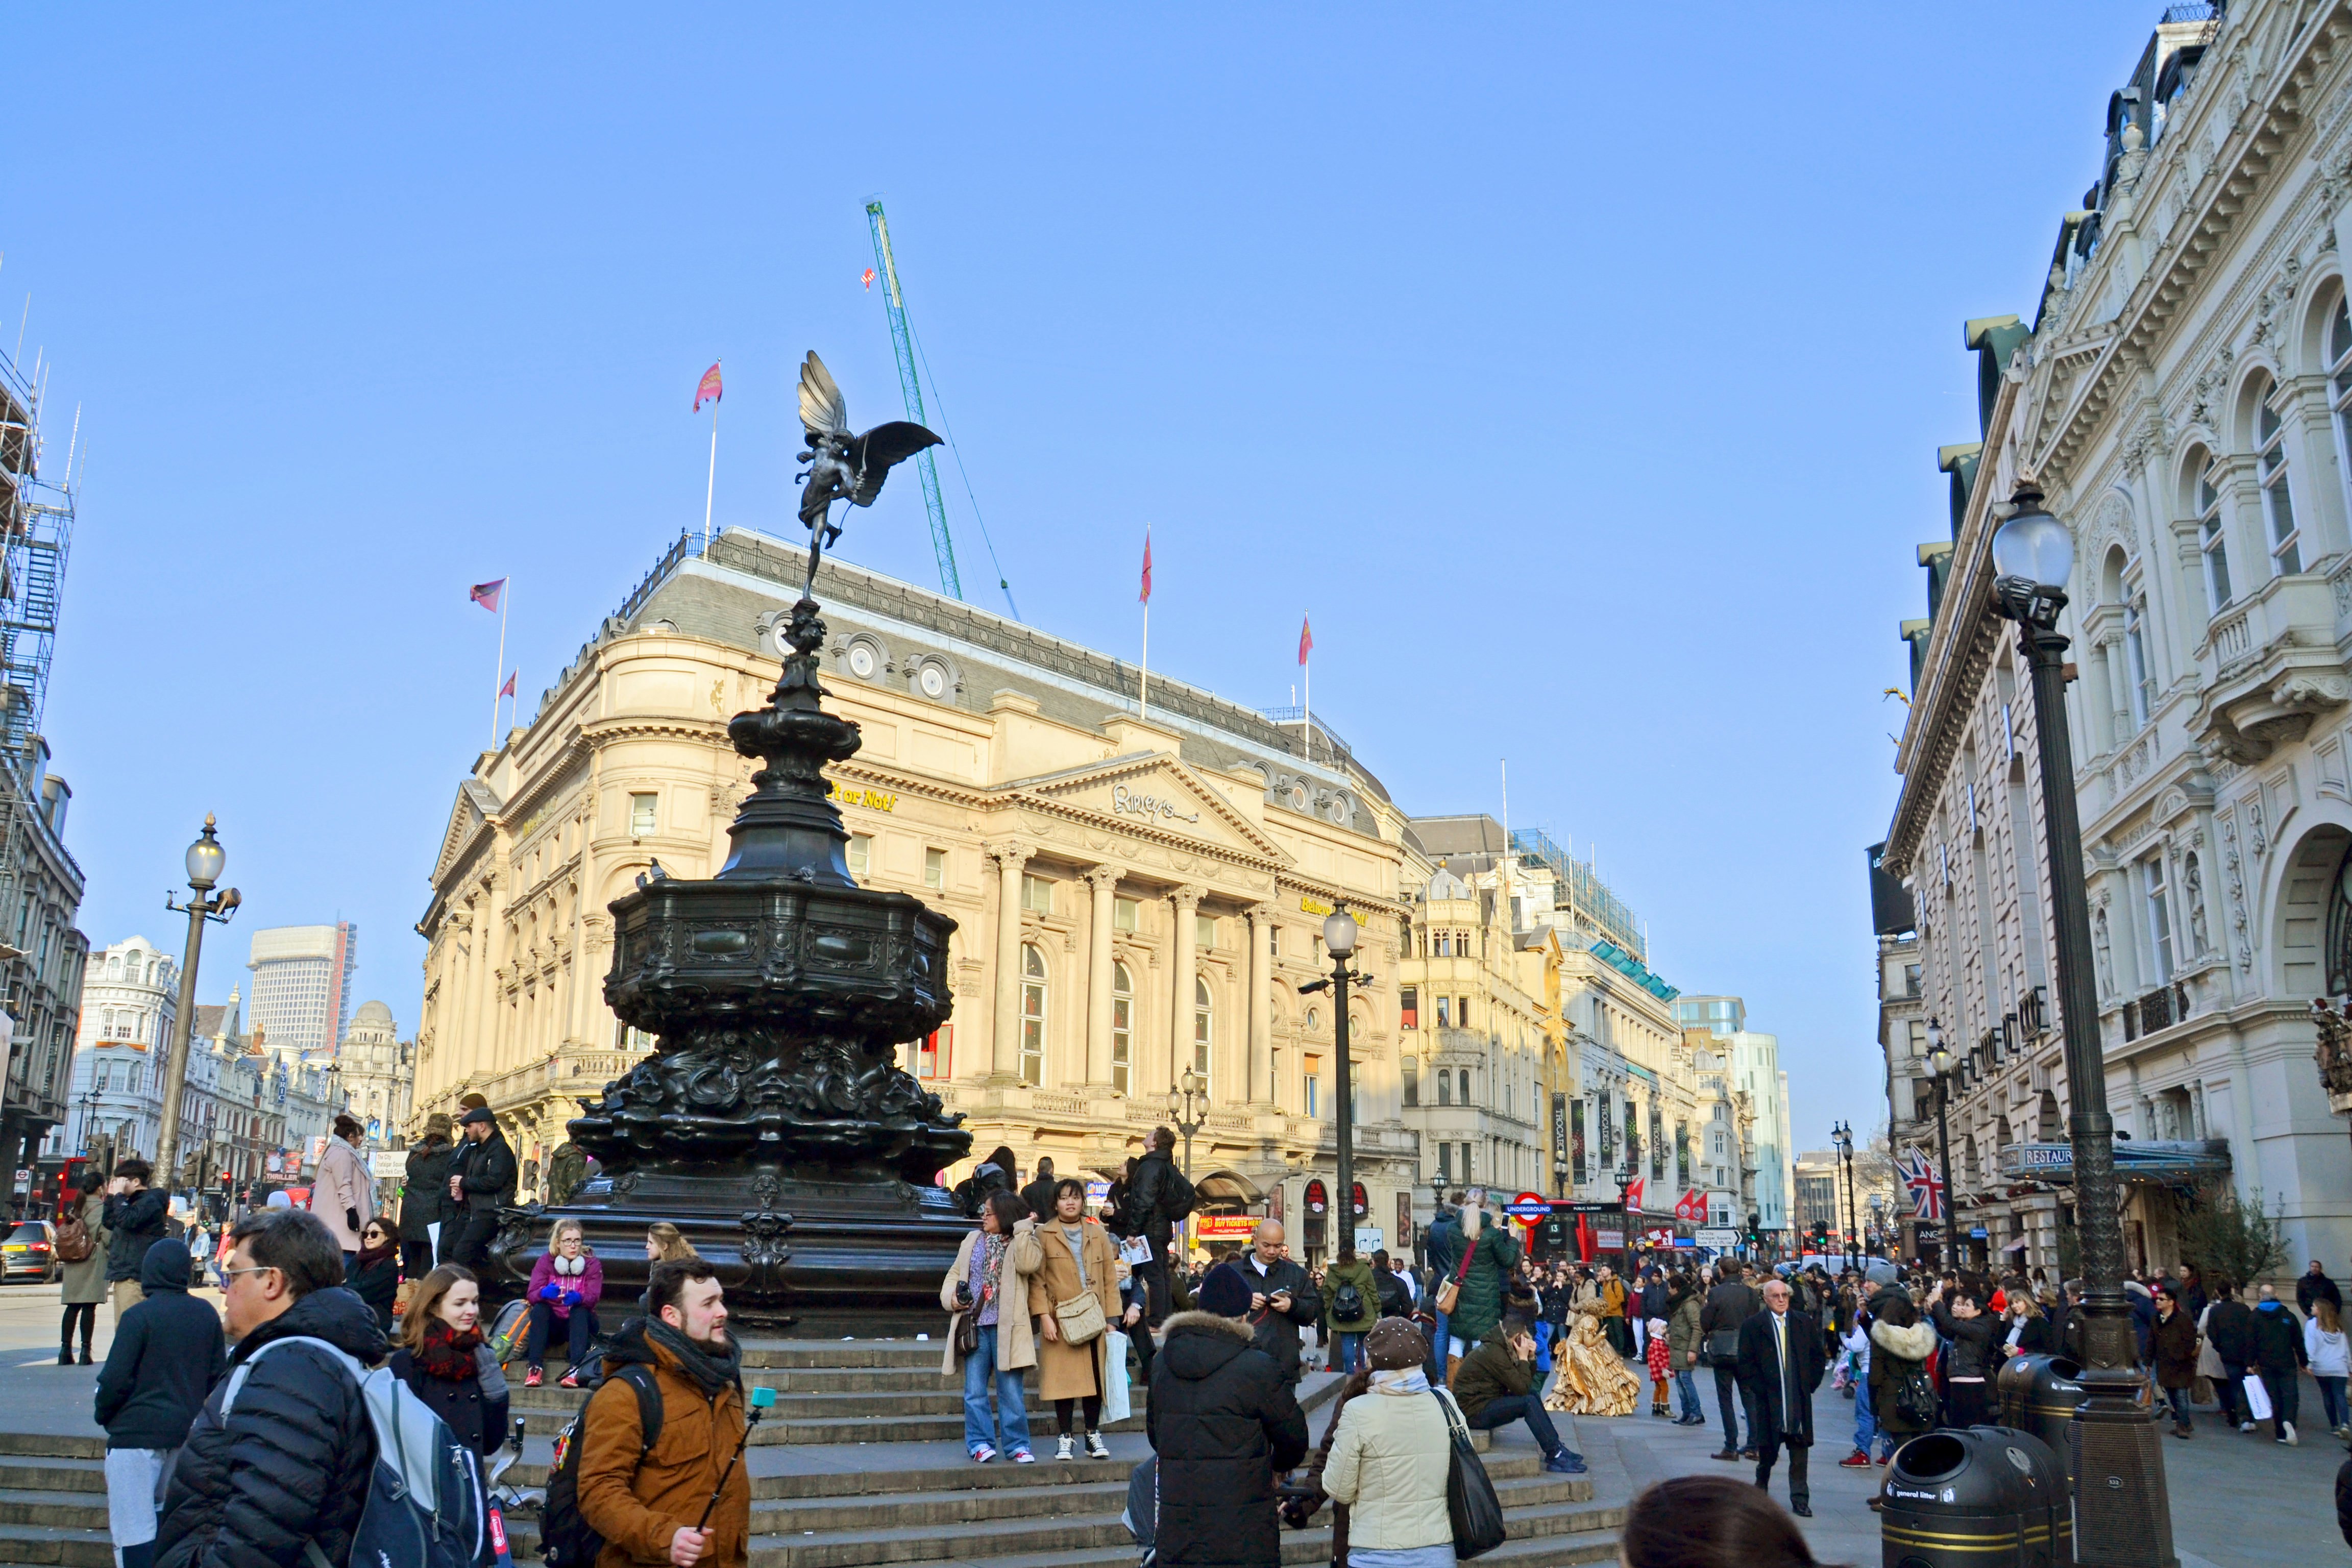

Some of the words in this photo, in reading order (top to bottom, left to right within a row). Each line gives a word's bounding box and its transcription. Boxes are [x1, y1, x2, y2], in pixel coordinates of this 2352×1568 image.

[844, 790, 861, 803] or
[863, 790, 897, 812] Not!
[1300, 897, 1332, 917] Believe
[279, 1068, 287, 1101] LYRIC
[317, 1069, 326, 1101] APOLLO
[1601, 1103, 1610, 1152] TROCADERO
[2026, 1150, 2073, 1164] RESTAUR
[1551, 1224, 1558, 1233] 13
[1662, 1229, 1673, 1246] £1
[1920, 1491, 1936, 1500] litter
